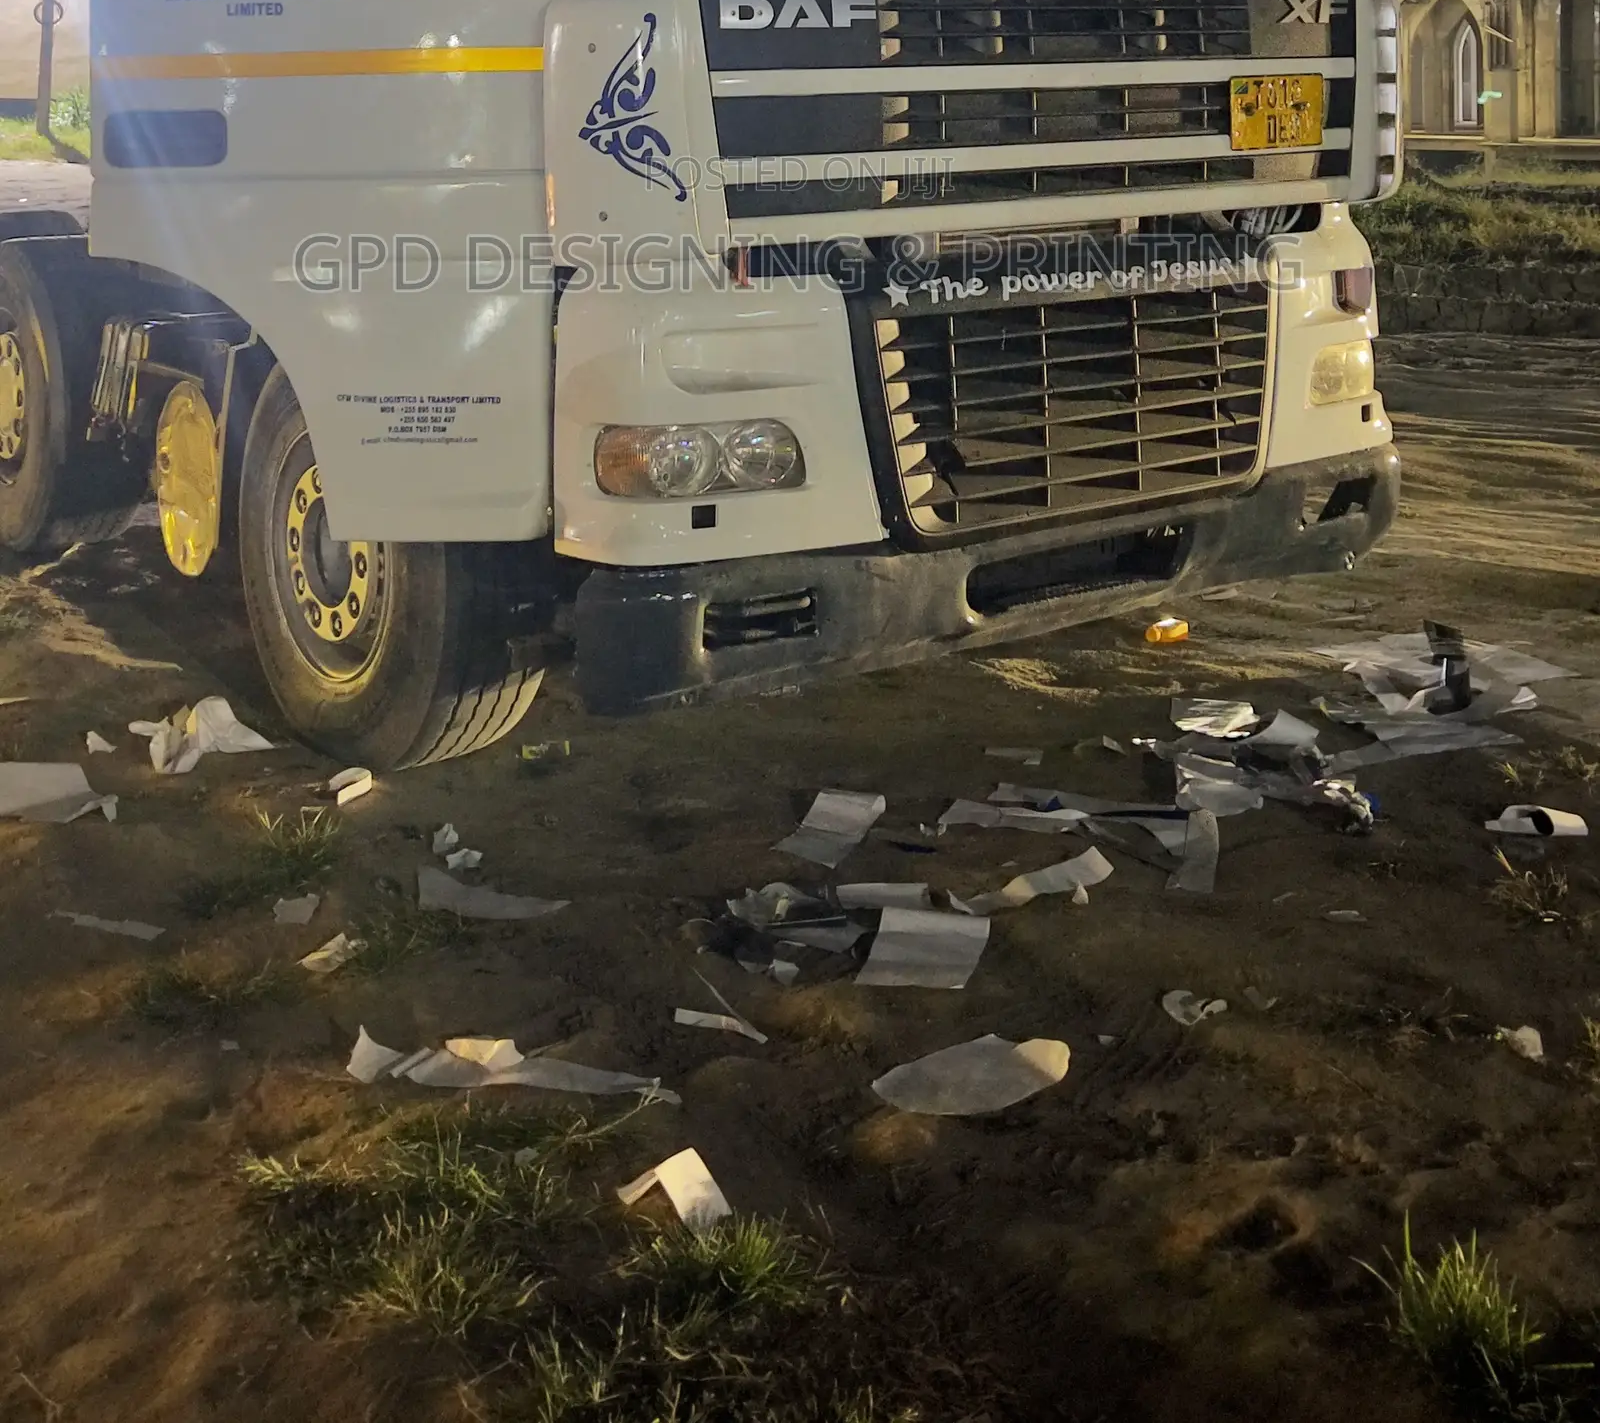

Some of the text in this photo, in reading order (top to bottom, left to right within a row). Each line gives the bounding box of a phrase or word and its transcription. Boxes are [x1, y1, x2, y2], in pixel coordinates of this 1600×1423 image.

[226, 2, 284, 17] LIMITED
[920, 256, 1233, 305] The power of Jesus
[379, 396, 417, 404] LOGISTICS
[427, 396, 471, 404] TRANSPORT
[472, 396, 502, 405] LIMITED
